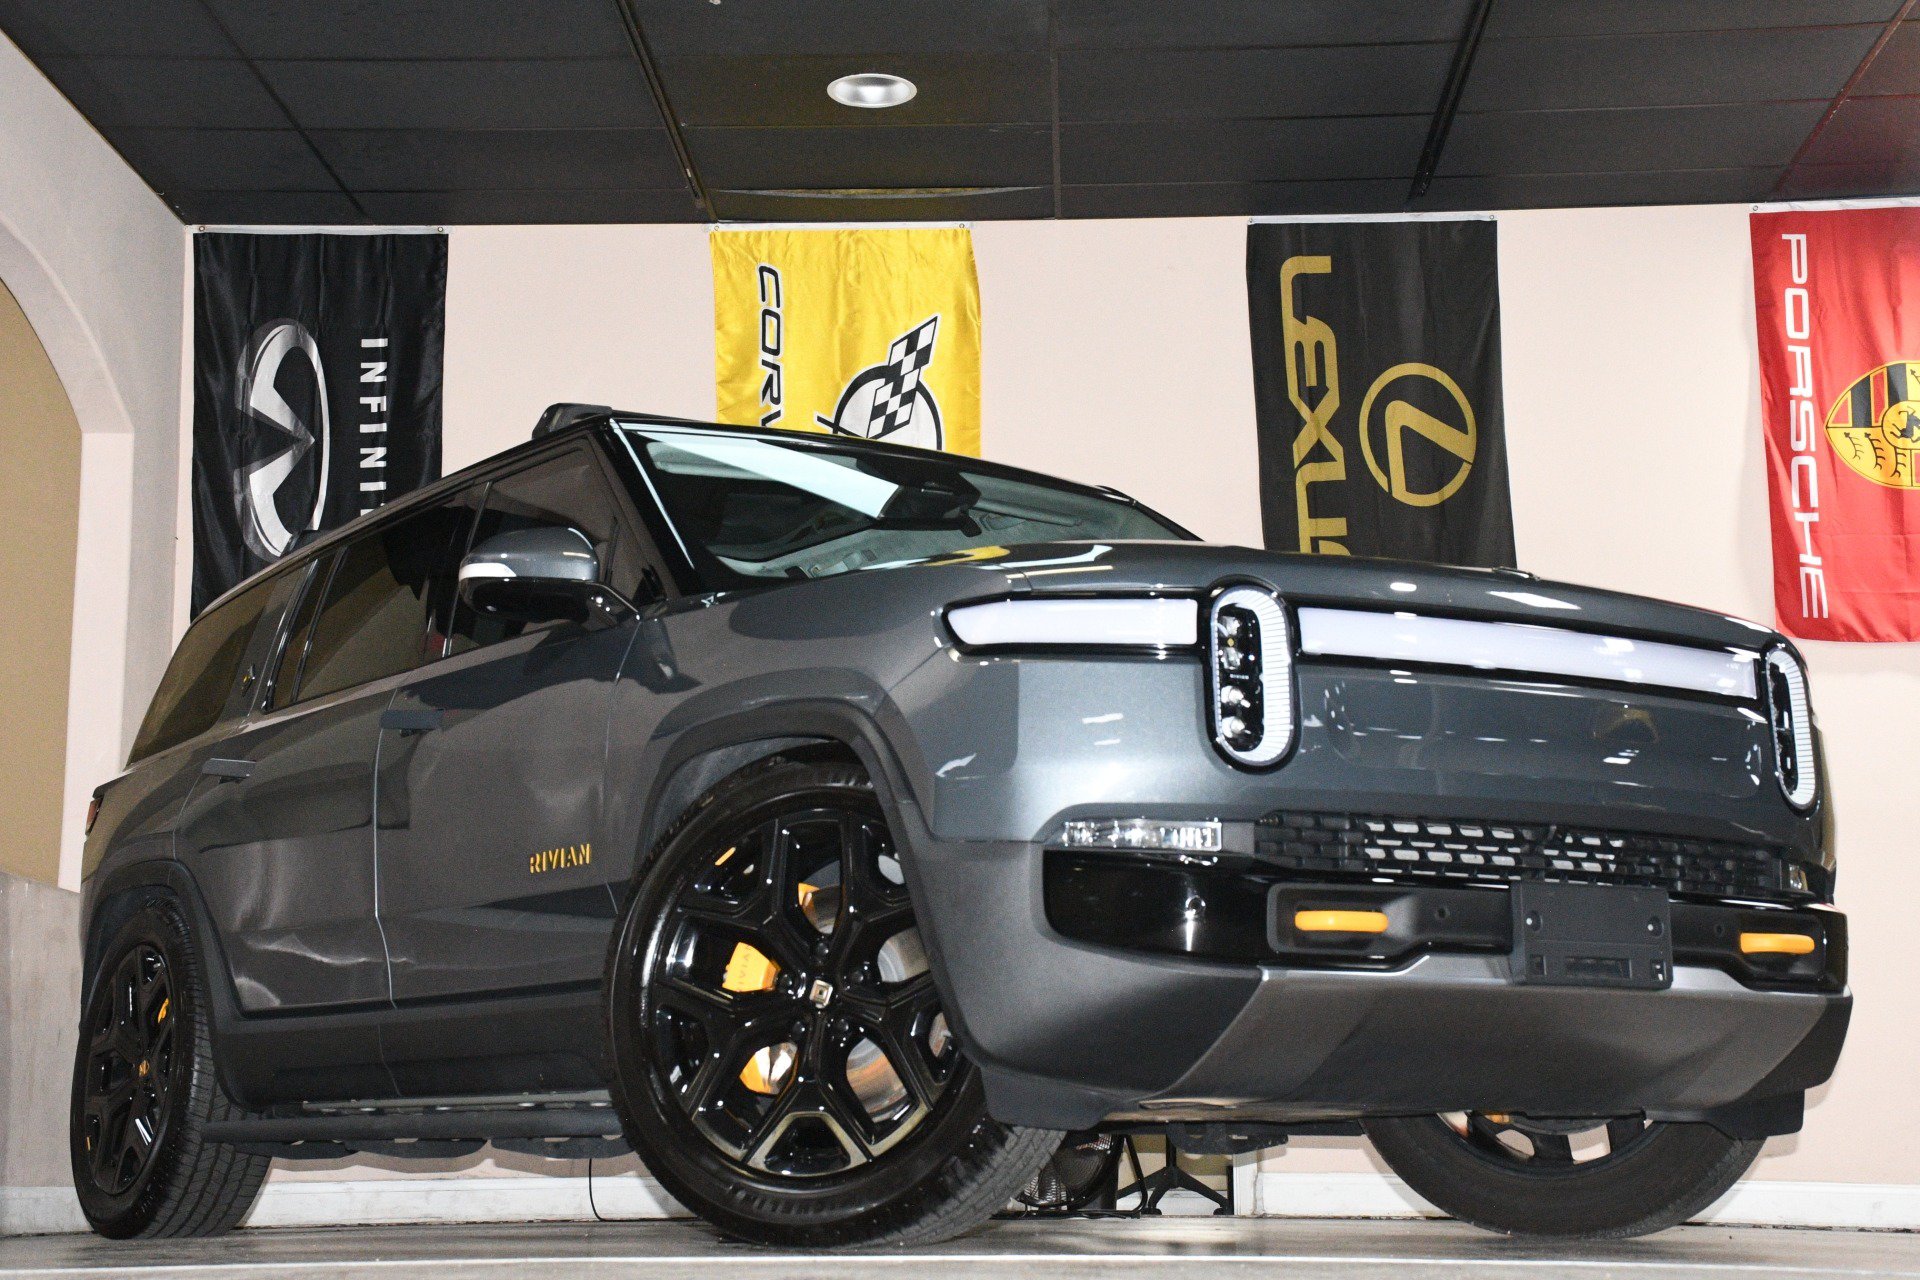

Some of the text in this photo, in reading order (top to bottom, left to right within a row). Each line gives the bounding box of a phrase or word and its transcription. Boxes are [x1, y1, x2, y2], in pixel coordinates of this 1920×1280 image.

[359, 338, 389, 517] INFINI
[1280, 255, 1352, 557] LEXU
[1781, 233, 1829, 619] PORSCHE
[529, 843, 591, 874] RIVIAN
